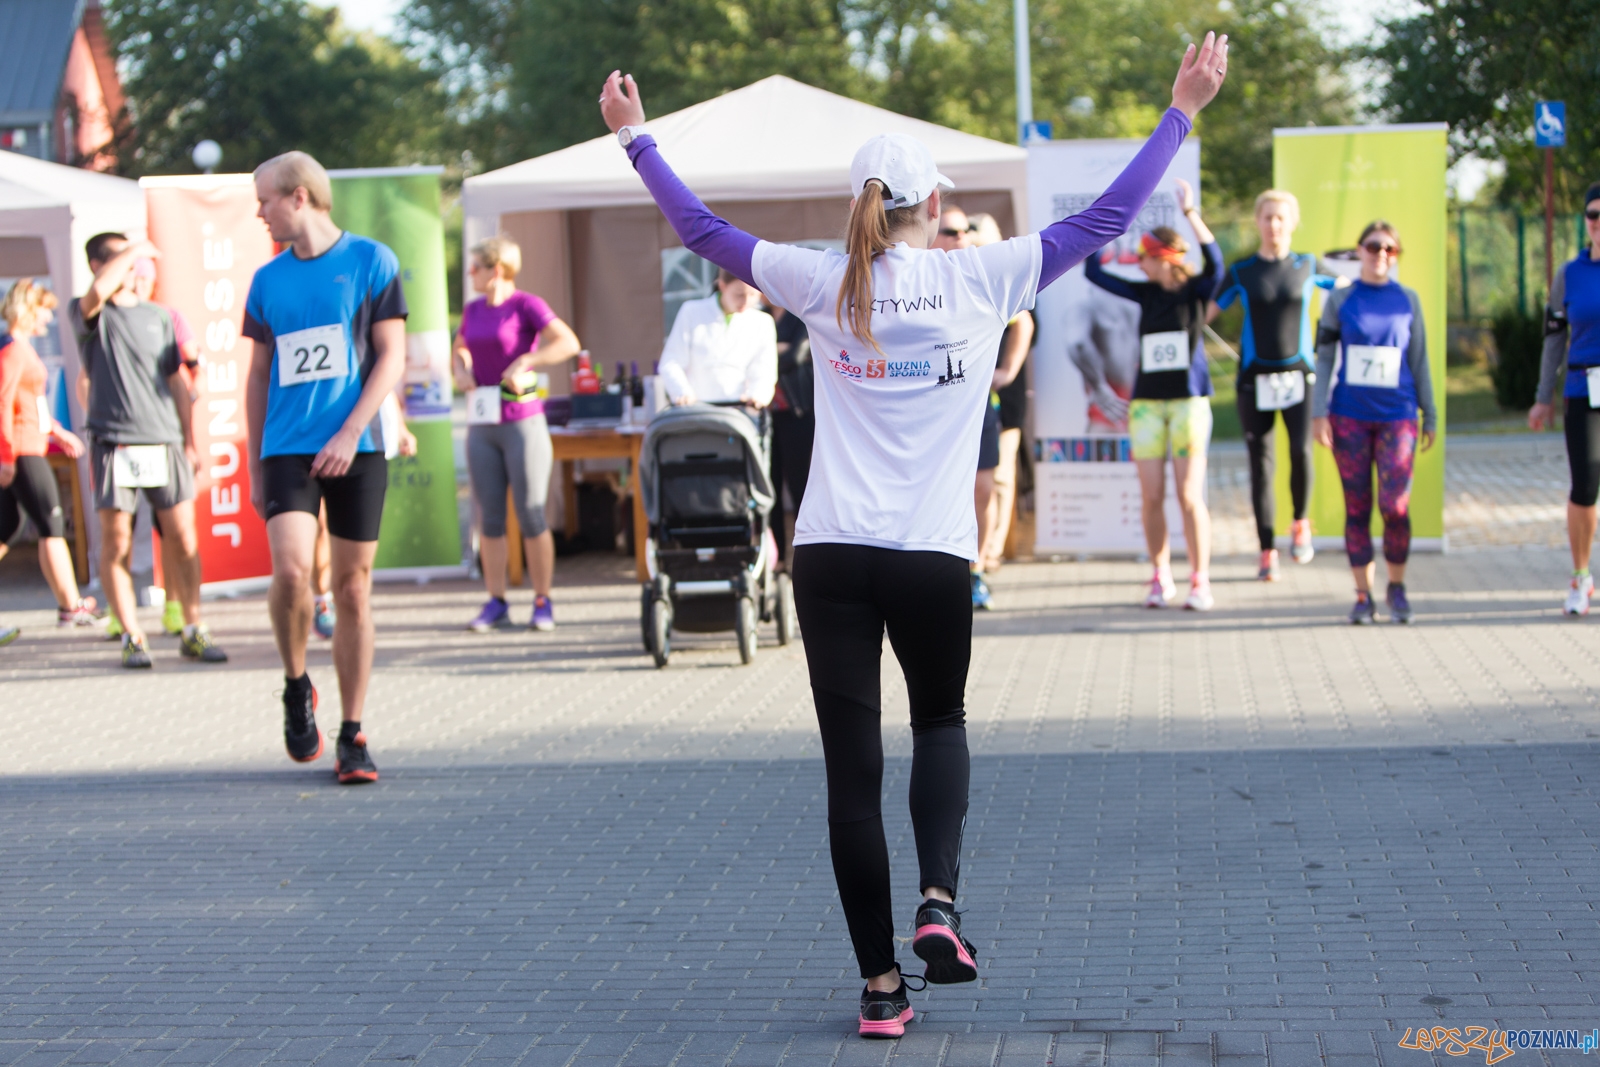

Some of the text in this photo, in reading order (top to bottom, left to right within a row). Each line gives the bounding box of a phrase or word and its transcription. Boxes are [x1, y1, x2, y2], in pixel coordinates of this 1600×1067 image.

[851, 294, 942, 314] KTYWNI
[293, 343, 332, 375] 22
[1153, 343, 1178, 363] 69
[829, 359, 862, 375] TESCO
[889, 369, 930, 377] SPORTU
[1361, 358, 1385, 379] 71
[203, 237, 242, 548] JEUNESSE
